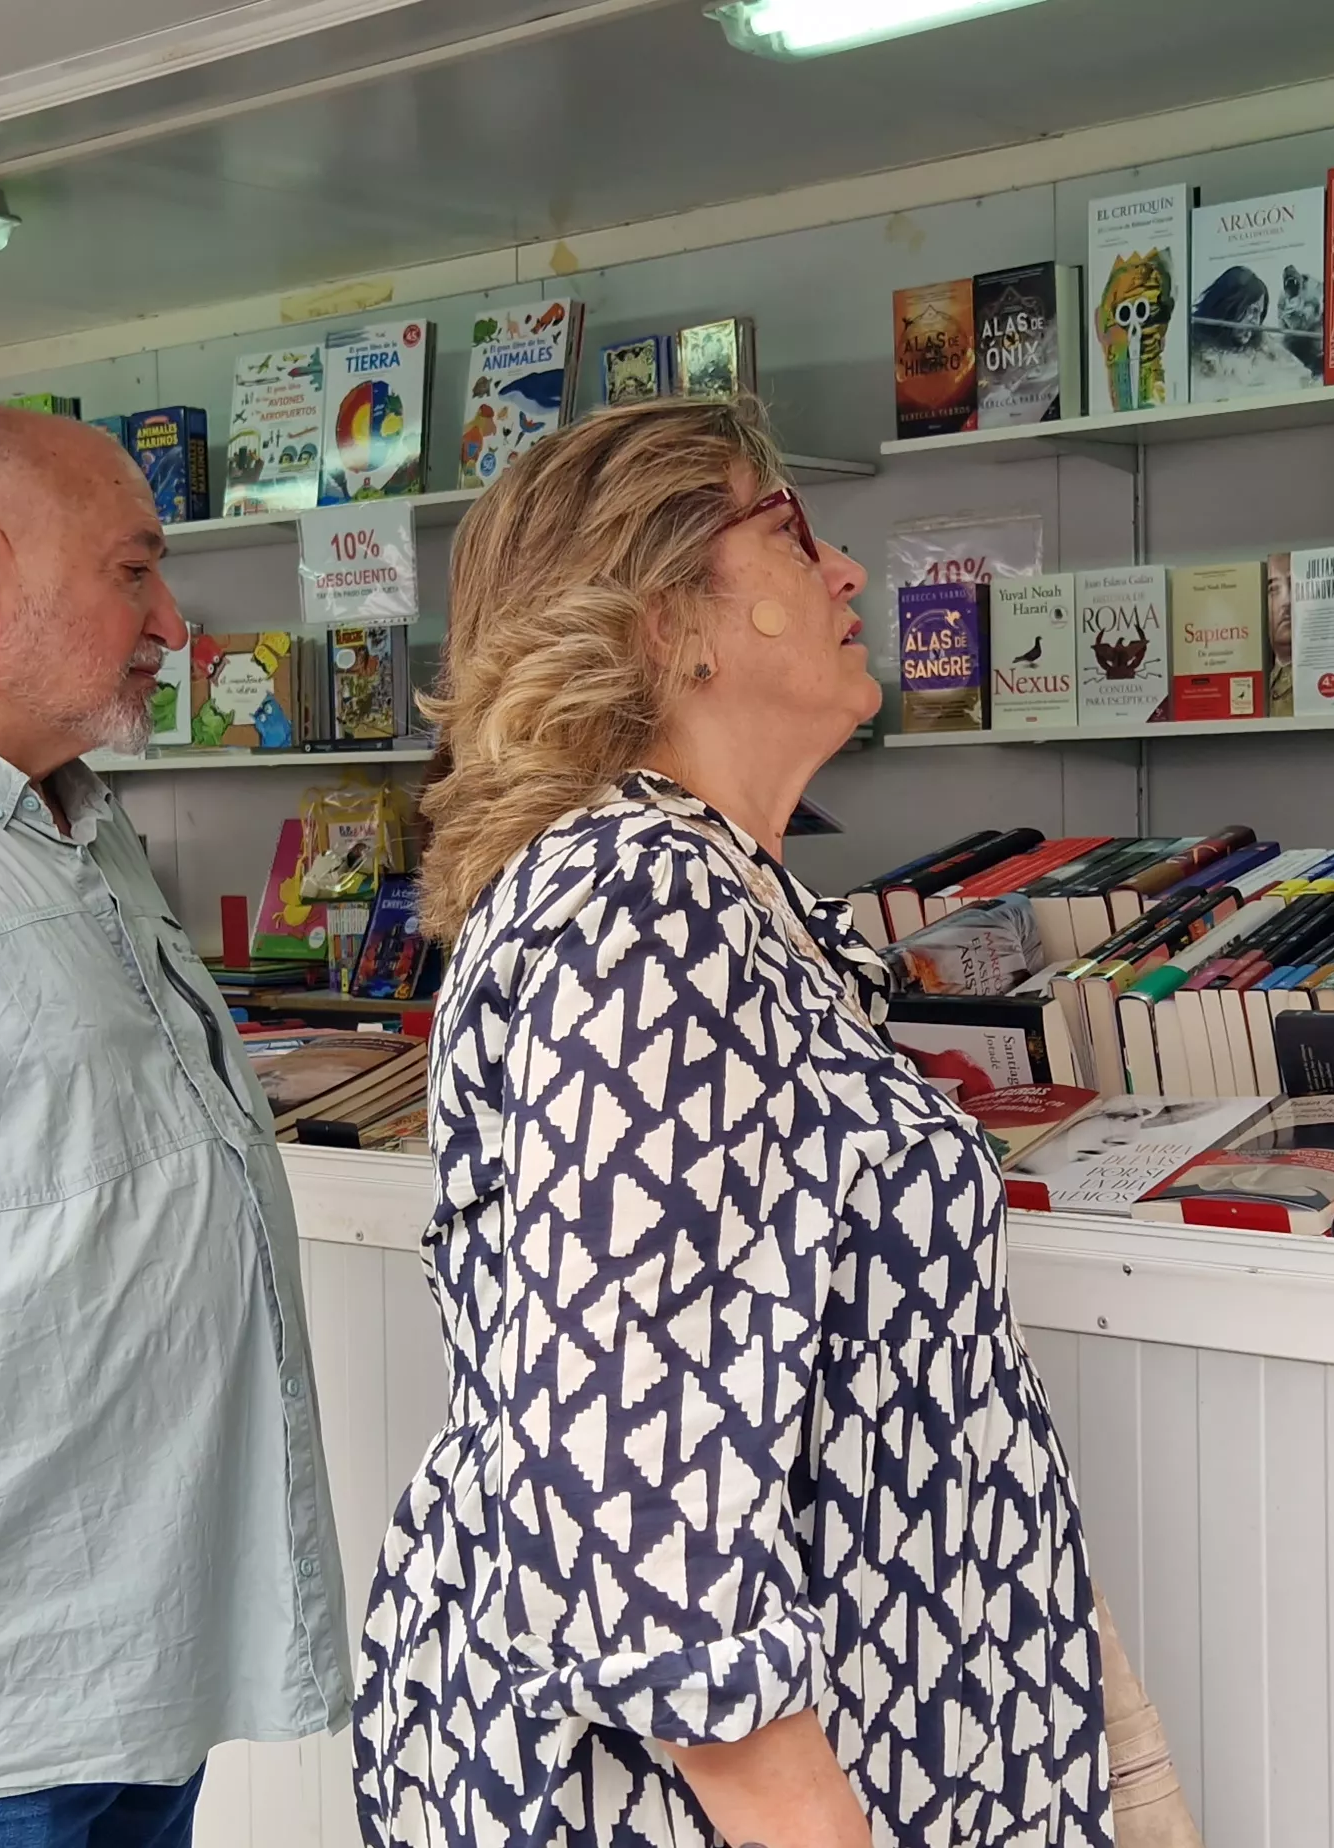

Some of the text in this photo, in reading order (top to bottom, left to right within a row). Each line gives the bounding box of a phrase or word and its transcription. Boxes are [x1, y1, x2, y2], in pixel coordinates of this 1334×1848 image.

[1097, 196, 1175, 222] EL CRITIQUÍN
[1217, 203, 1297, 234] ARAGÓN
[981, 311, 1045, 339] ALAS DE
[903, 331, 960, 354] ALAS DE
[346, 351, 401, 373] TIERRA
[483, 346, 554, 372] ANIMALES
[985, 339, 1040, 372] ÓNIX
[267, 394, 306, 408] AVIONES
[259, 406, 317, 422] AEROPUERTOS
[136, 421, 178, 440] ANIMALES
[136, 433, 178, 451] MARINOS
[331, 528, 381, 562] 10%
[316, 567, 398, 589] DESCUENTO
[998, 585, 1062, 603] Yuval Noah
[1012, 602, 1049, 616] Harari
[1082, 602, 1161, 634] ROMA
[904, 628, 968, 654] ALAS DE
[1183, 622, 1250, 649] Sapiens
[904, 655, 973, 680] SANGRE
[993, 667, 1071, 696] Nexus
[1098, 684, 1144, 695] CONTADA
[1085, 693, 1159, 707] PARA ESCÉPTICOS
[971, 937, 980, 956] EL
[983, 1031, 1000, 1071] Jotadé
[1086, 1166, 1140, 1179] POR
[1078, 1178, 1109, 1190] UN
